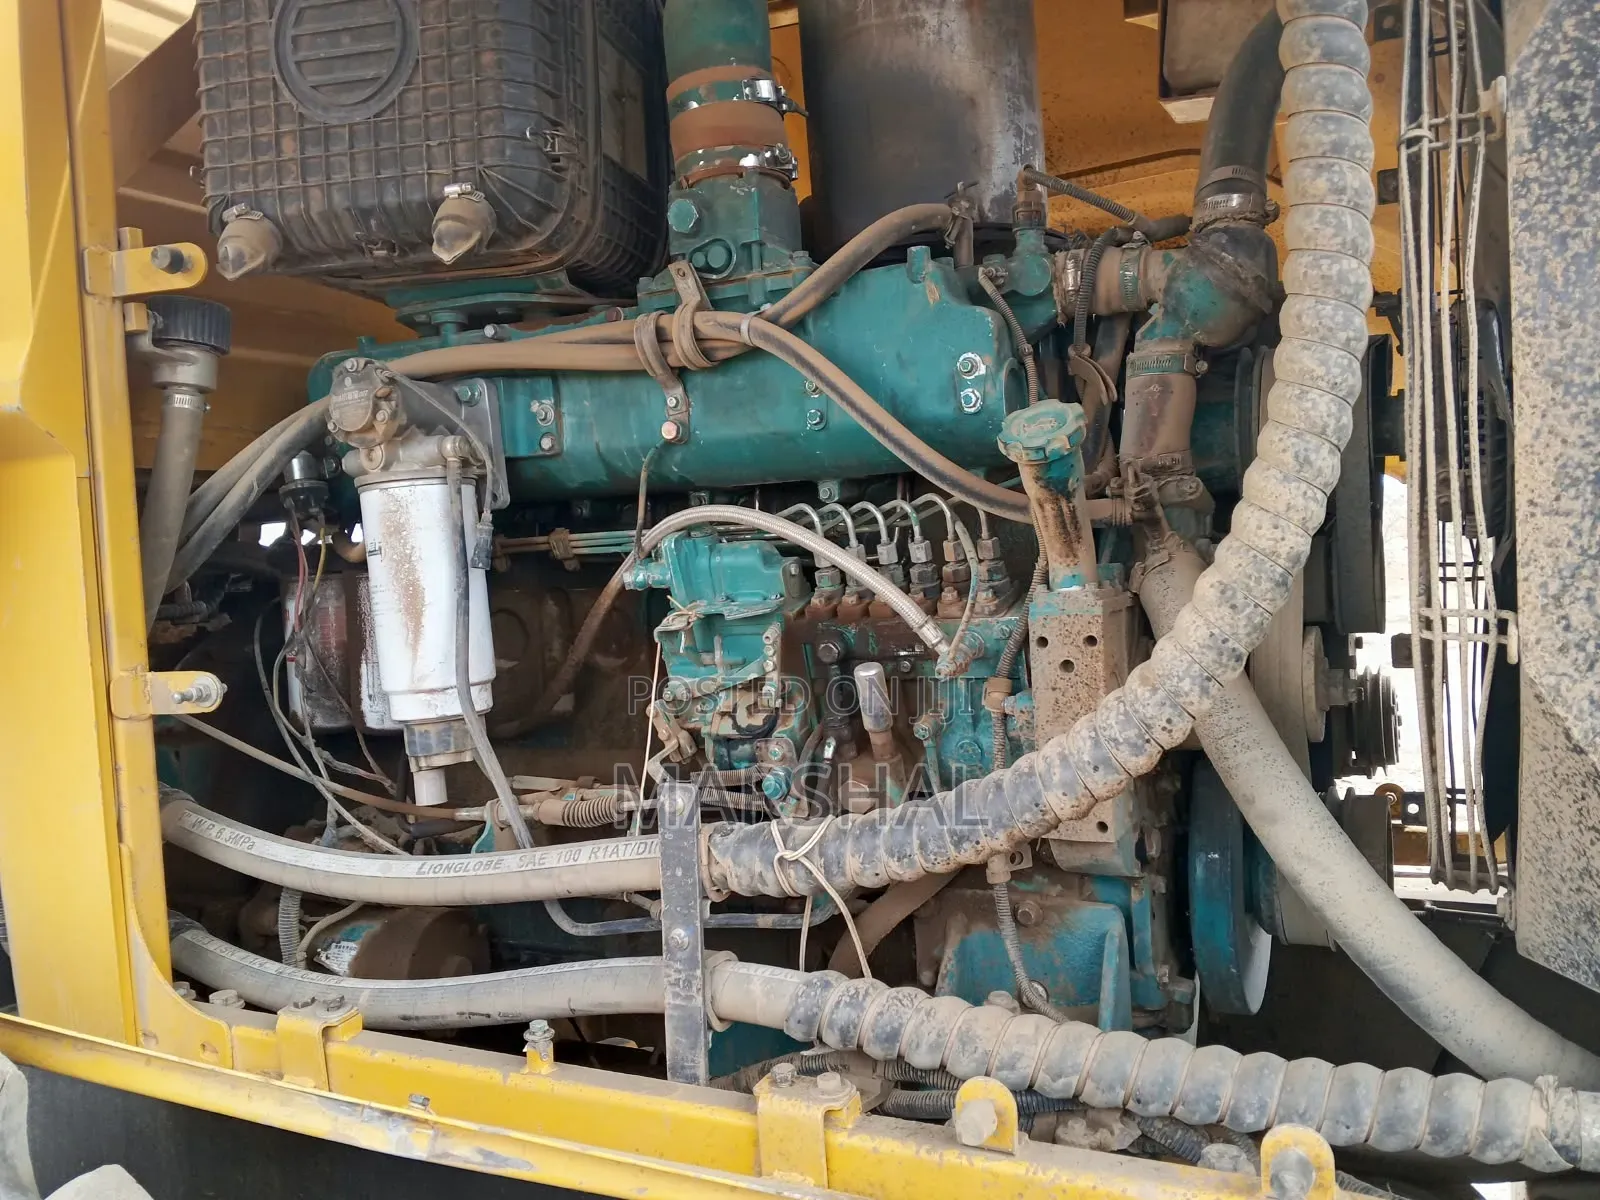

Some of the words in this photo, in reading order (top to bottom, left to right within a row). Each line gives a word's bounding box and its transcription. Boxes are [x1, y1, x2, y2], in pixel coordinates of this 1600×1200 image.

[416, 858, 505, 875] LIONGLOBE
[518, 852, 546, 869] SAE
[556, 848, 581, 864] 100
